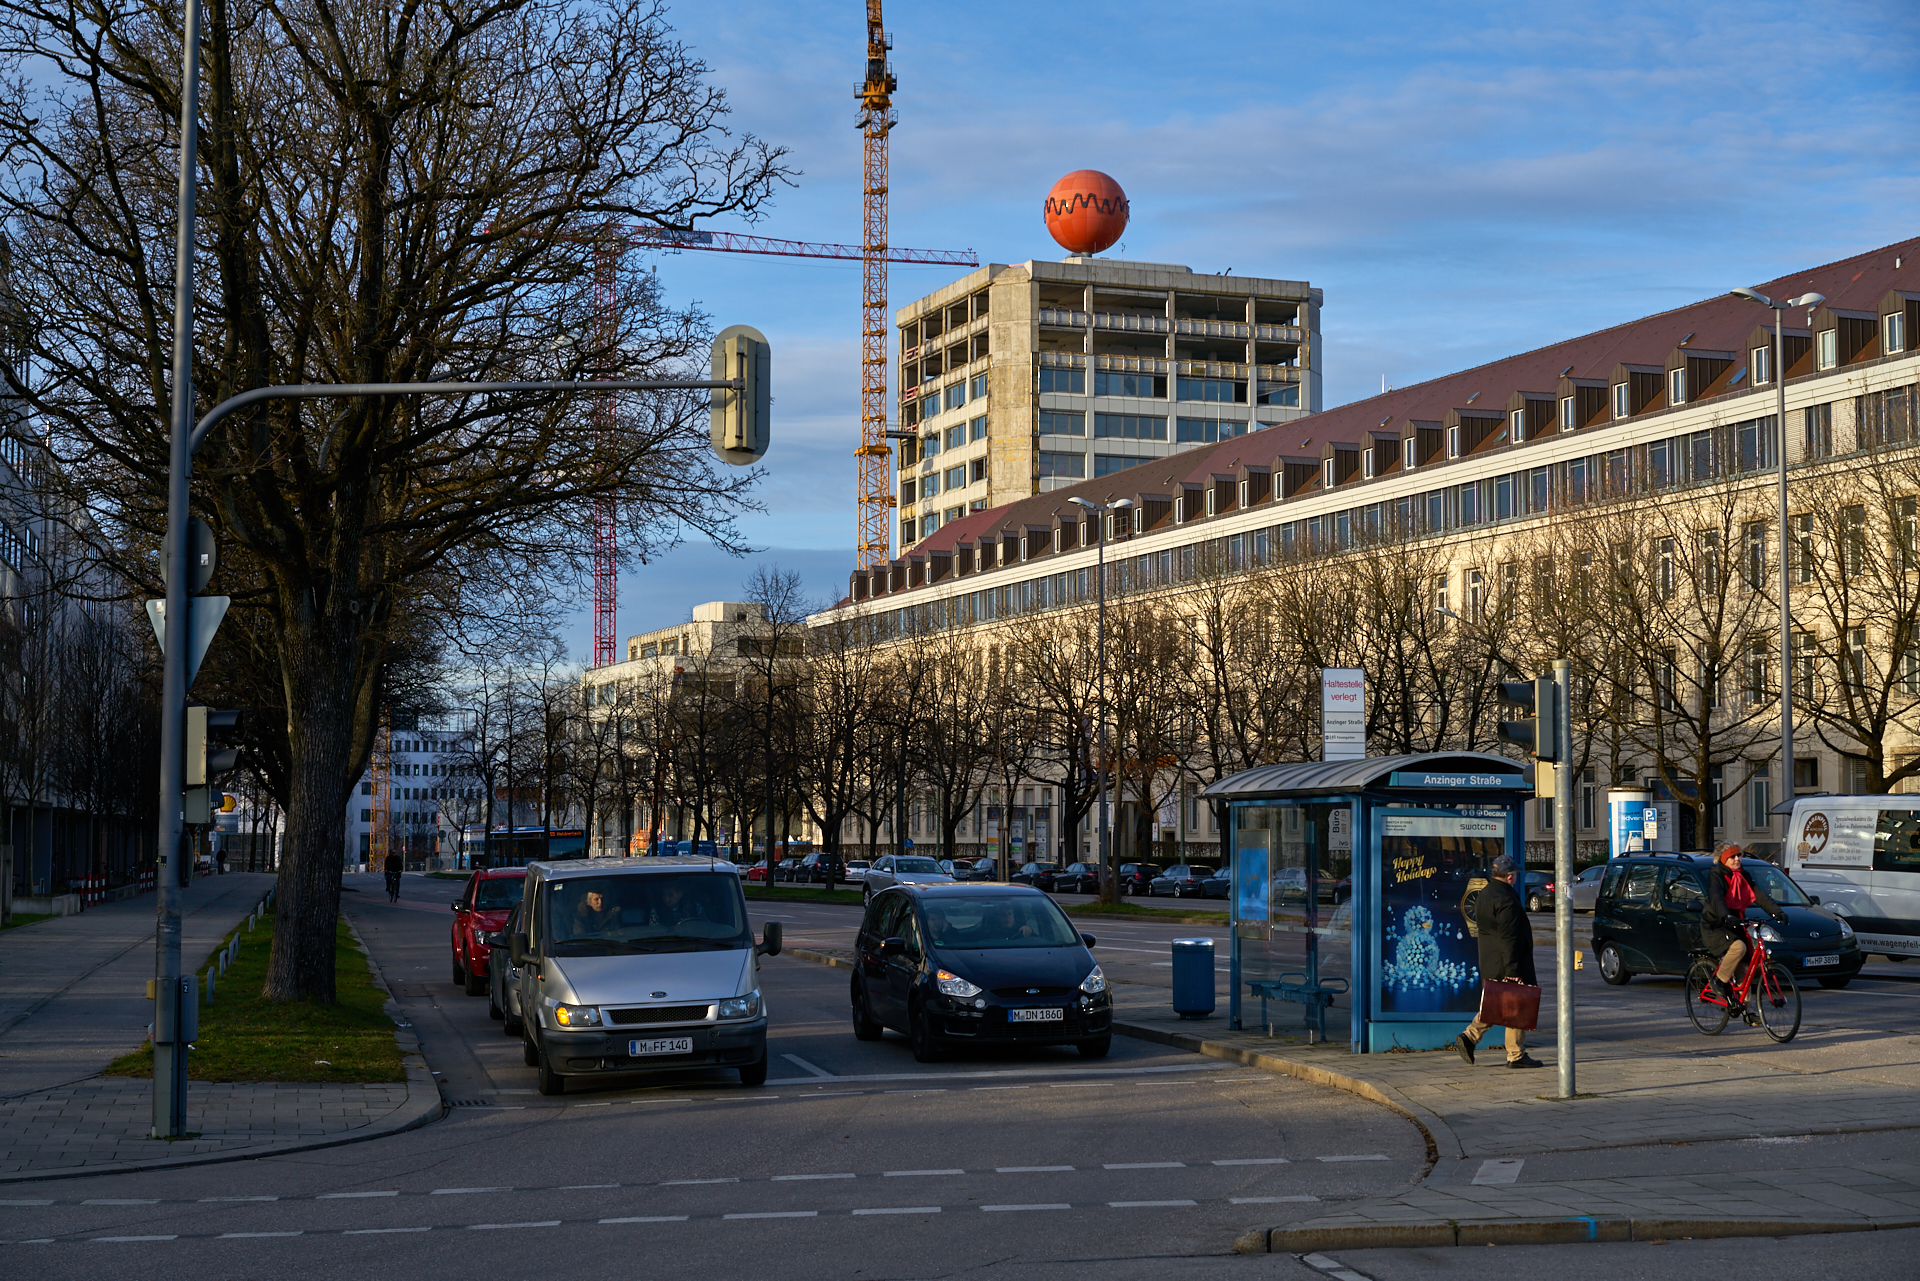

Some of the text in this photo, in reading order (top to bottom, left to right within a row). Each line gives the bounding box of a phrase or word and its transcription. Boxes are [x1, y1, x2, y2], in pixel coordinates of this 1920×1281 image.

[1324, 680, 1363, 688] Haltestelle
[1330, 693, 1358, 703] verlegt
[1423, 775, 1502, 786] Anzinger Straße
[1332, 810, 1340, 833] Büro
[1459, 823, 1490, 831] swatch
[1805, 815, 1828, 831] WAGENPFEIL
[1392, 854, 1425, 870] Happy
[1395, 866, 1438, 884] Holidays
[1806, 955, 1839, 965] M HP 3899
[1014, 1009, 1062, 1020] M DN 1860
[640, 1040, 688, 1052] M FF 140
